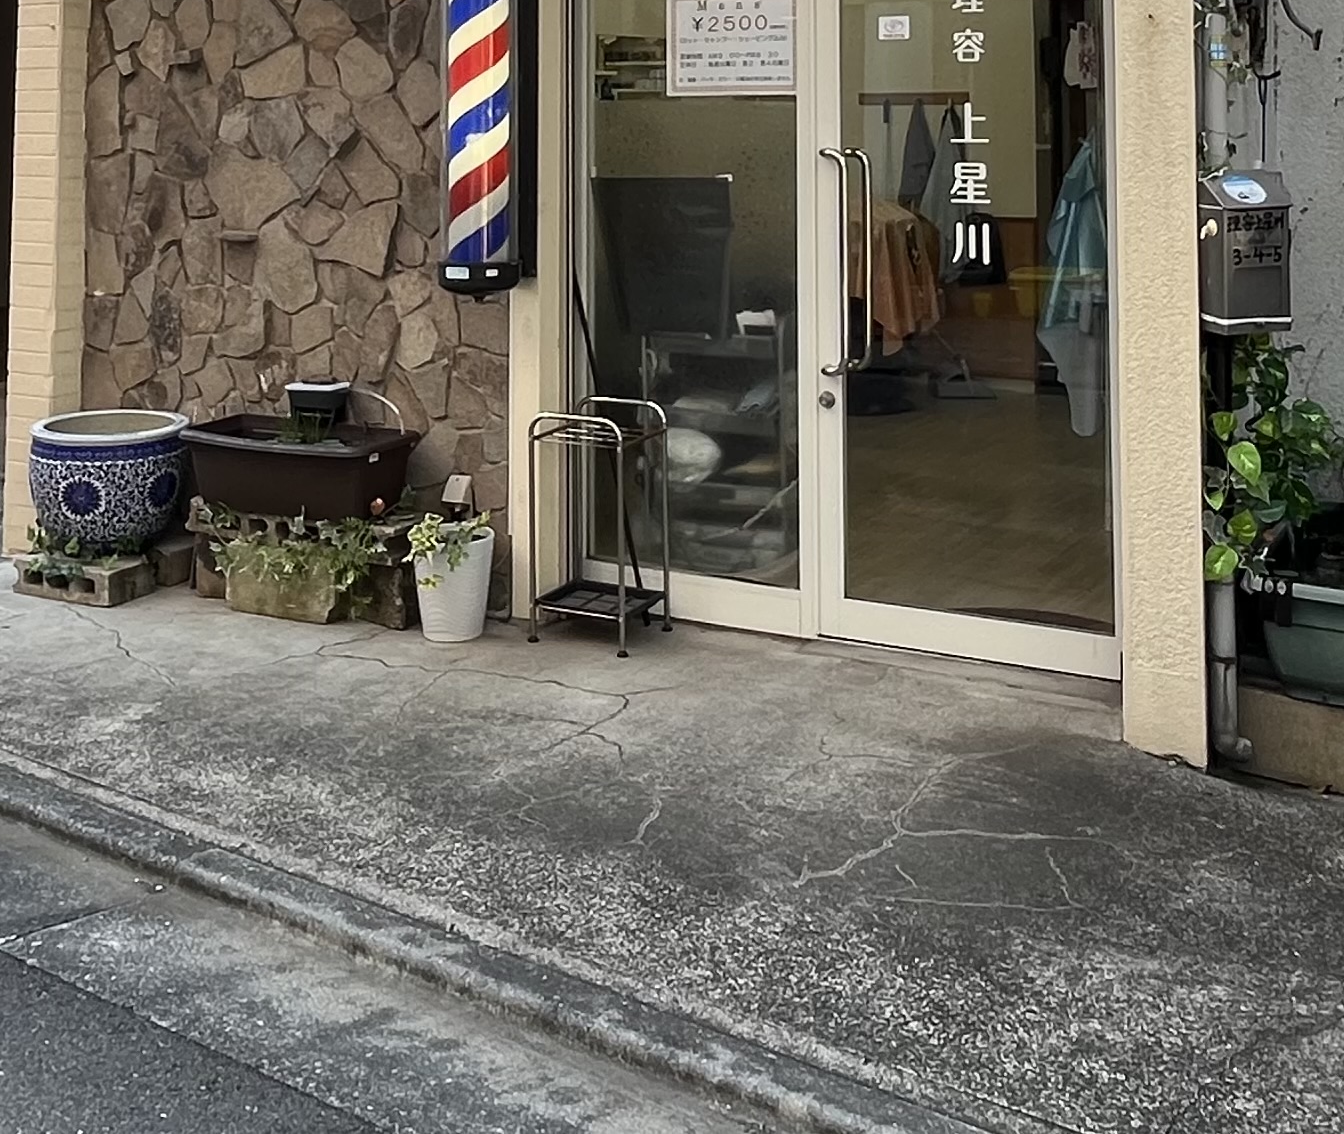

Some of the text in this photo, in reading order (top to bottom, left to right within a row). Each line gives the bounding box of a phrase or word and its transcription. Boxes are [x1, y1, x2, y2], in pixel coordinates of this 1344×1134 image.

[949, 101, 991, 266] 上星川
[1233, 246, 1283, 266] 3-4-5
